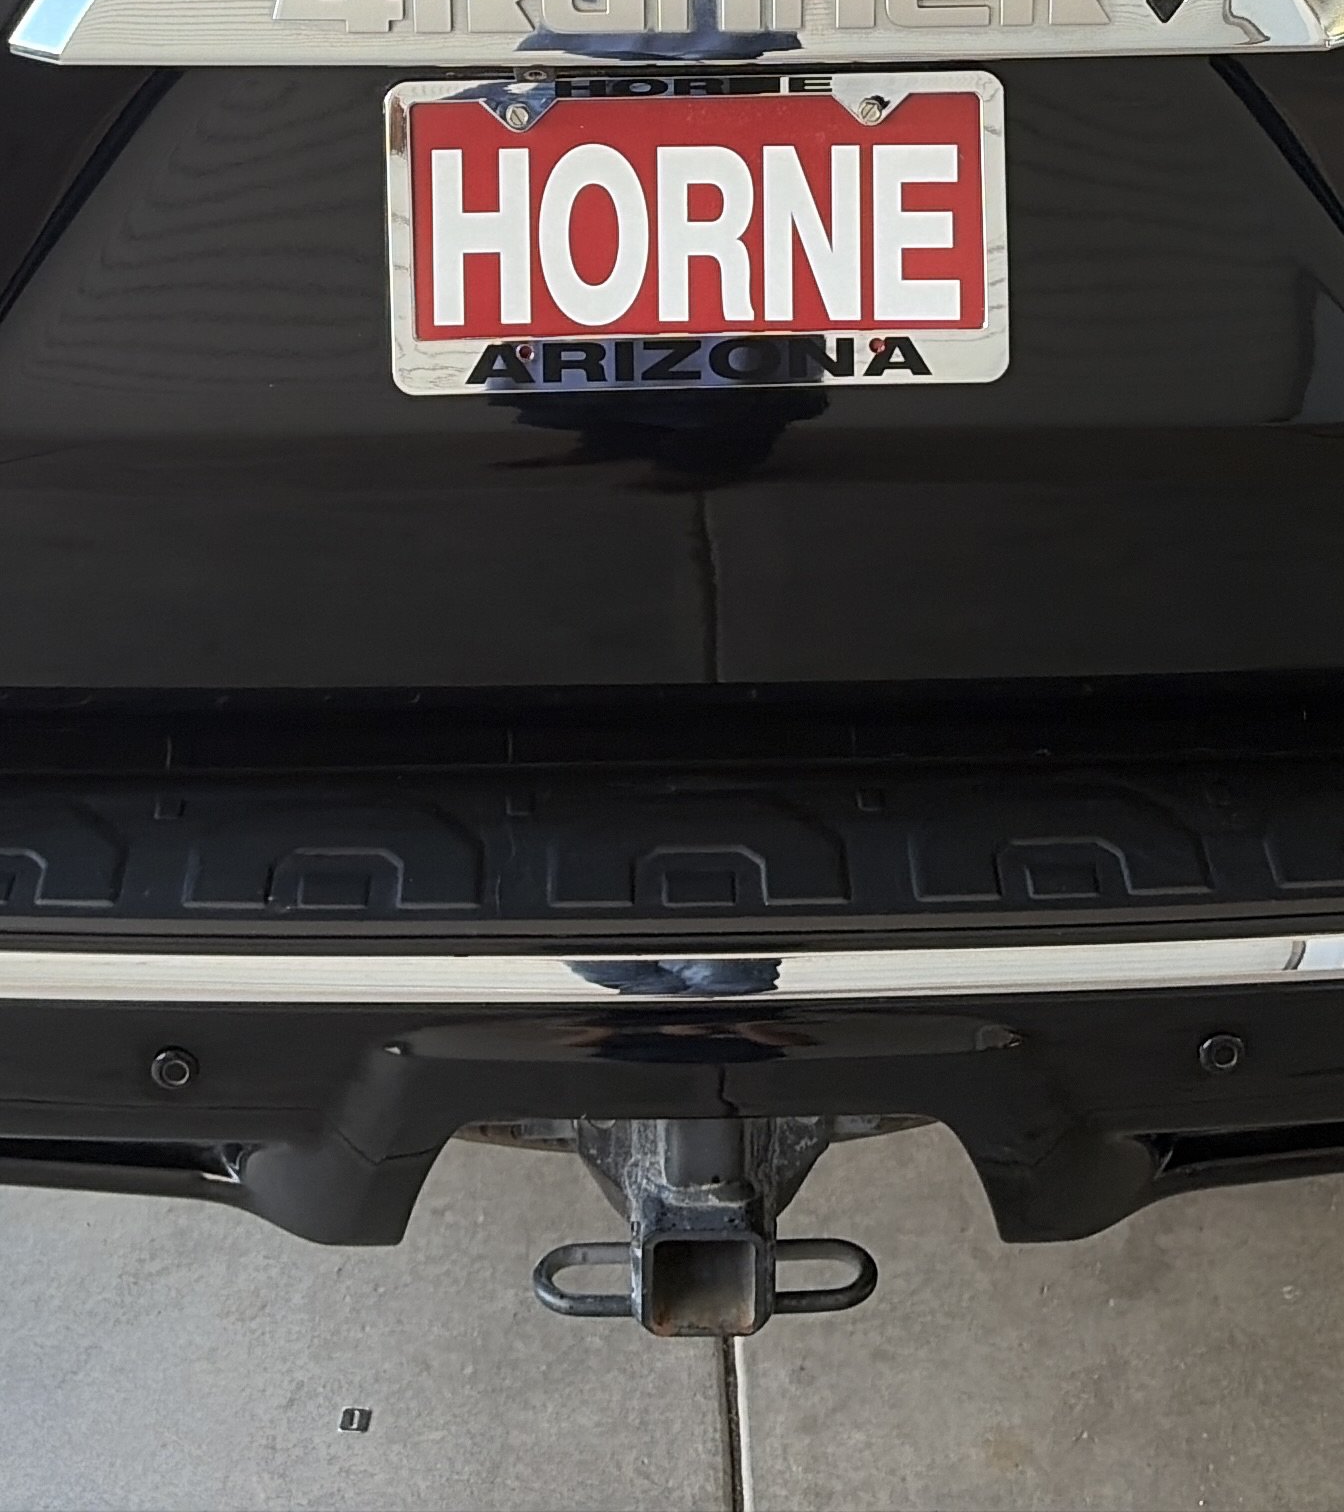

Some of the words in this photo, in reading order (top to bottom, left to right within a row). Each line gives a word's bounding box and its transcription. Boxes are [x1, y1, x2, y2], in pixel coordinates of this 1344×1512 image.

[554, 75, 834, 97] HORE
[430, 142, 962, 327] HORNE
[464, 335, 933, 385] ARIZONA
